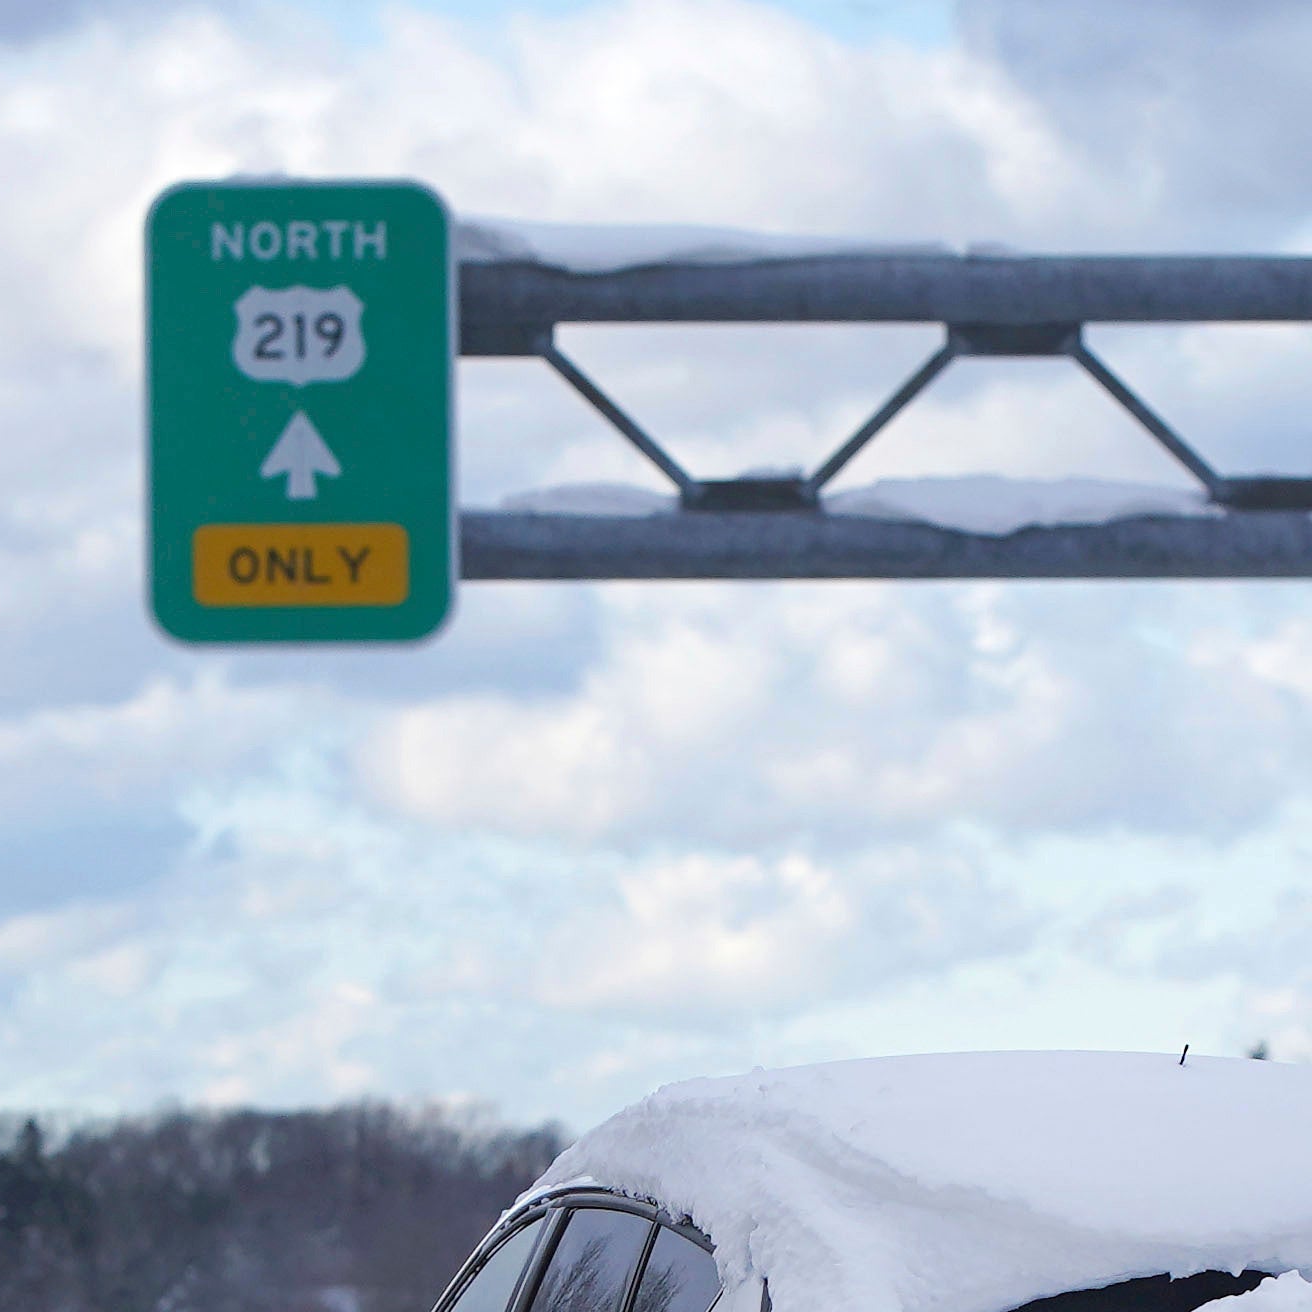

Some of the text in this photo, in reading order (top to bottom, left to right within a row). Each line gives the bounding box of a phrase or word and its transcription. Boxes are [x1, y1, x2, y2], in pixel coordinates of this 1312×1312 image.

[210, 220, 387, 260] NORTH
[253, 312, 345, 360] 219
[229, 547, 371, 584] ONLY
